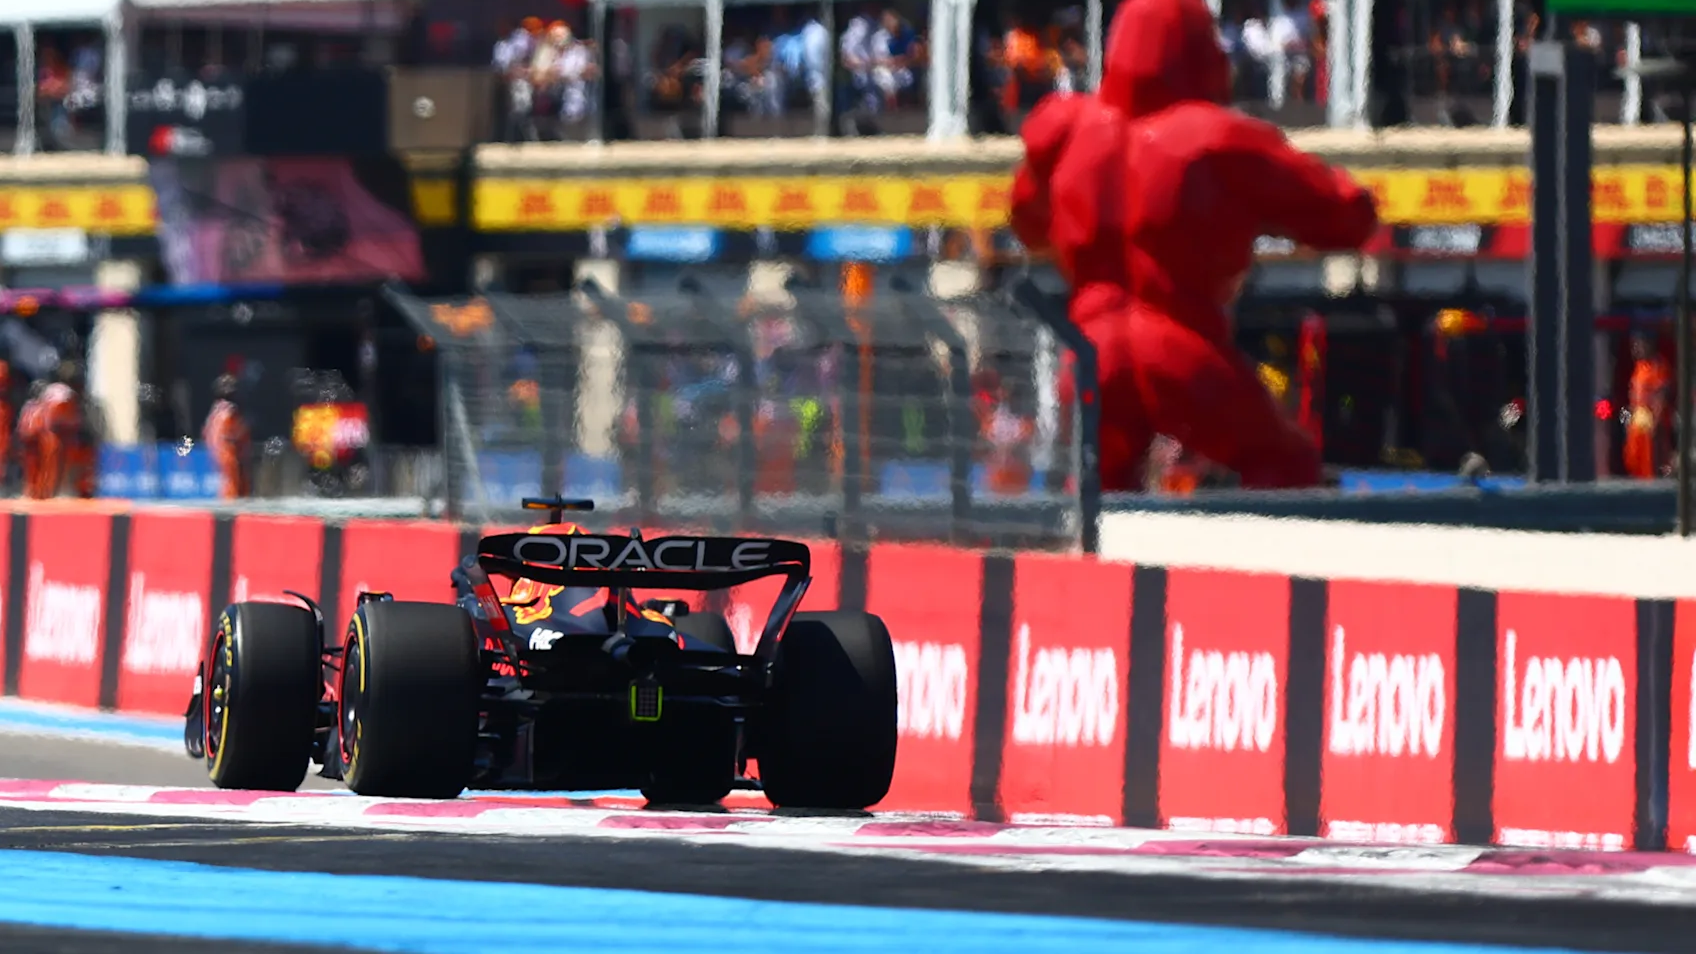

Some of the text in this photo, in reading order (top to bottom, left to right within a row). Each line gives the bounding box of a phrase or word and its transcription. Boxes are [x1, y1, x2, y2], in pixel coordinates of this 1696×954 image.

[512, 536, 772, 571] ORACLE
[1012, 623, 1119, 747] Lenovo
[1169, 623, 1278, 752] Lenovo
[1329, 625, 1446, 758] Lenovo
[1503, 630, 1626, 764] Lenovo
